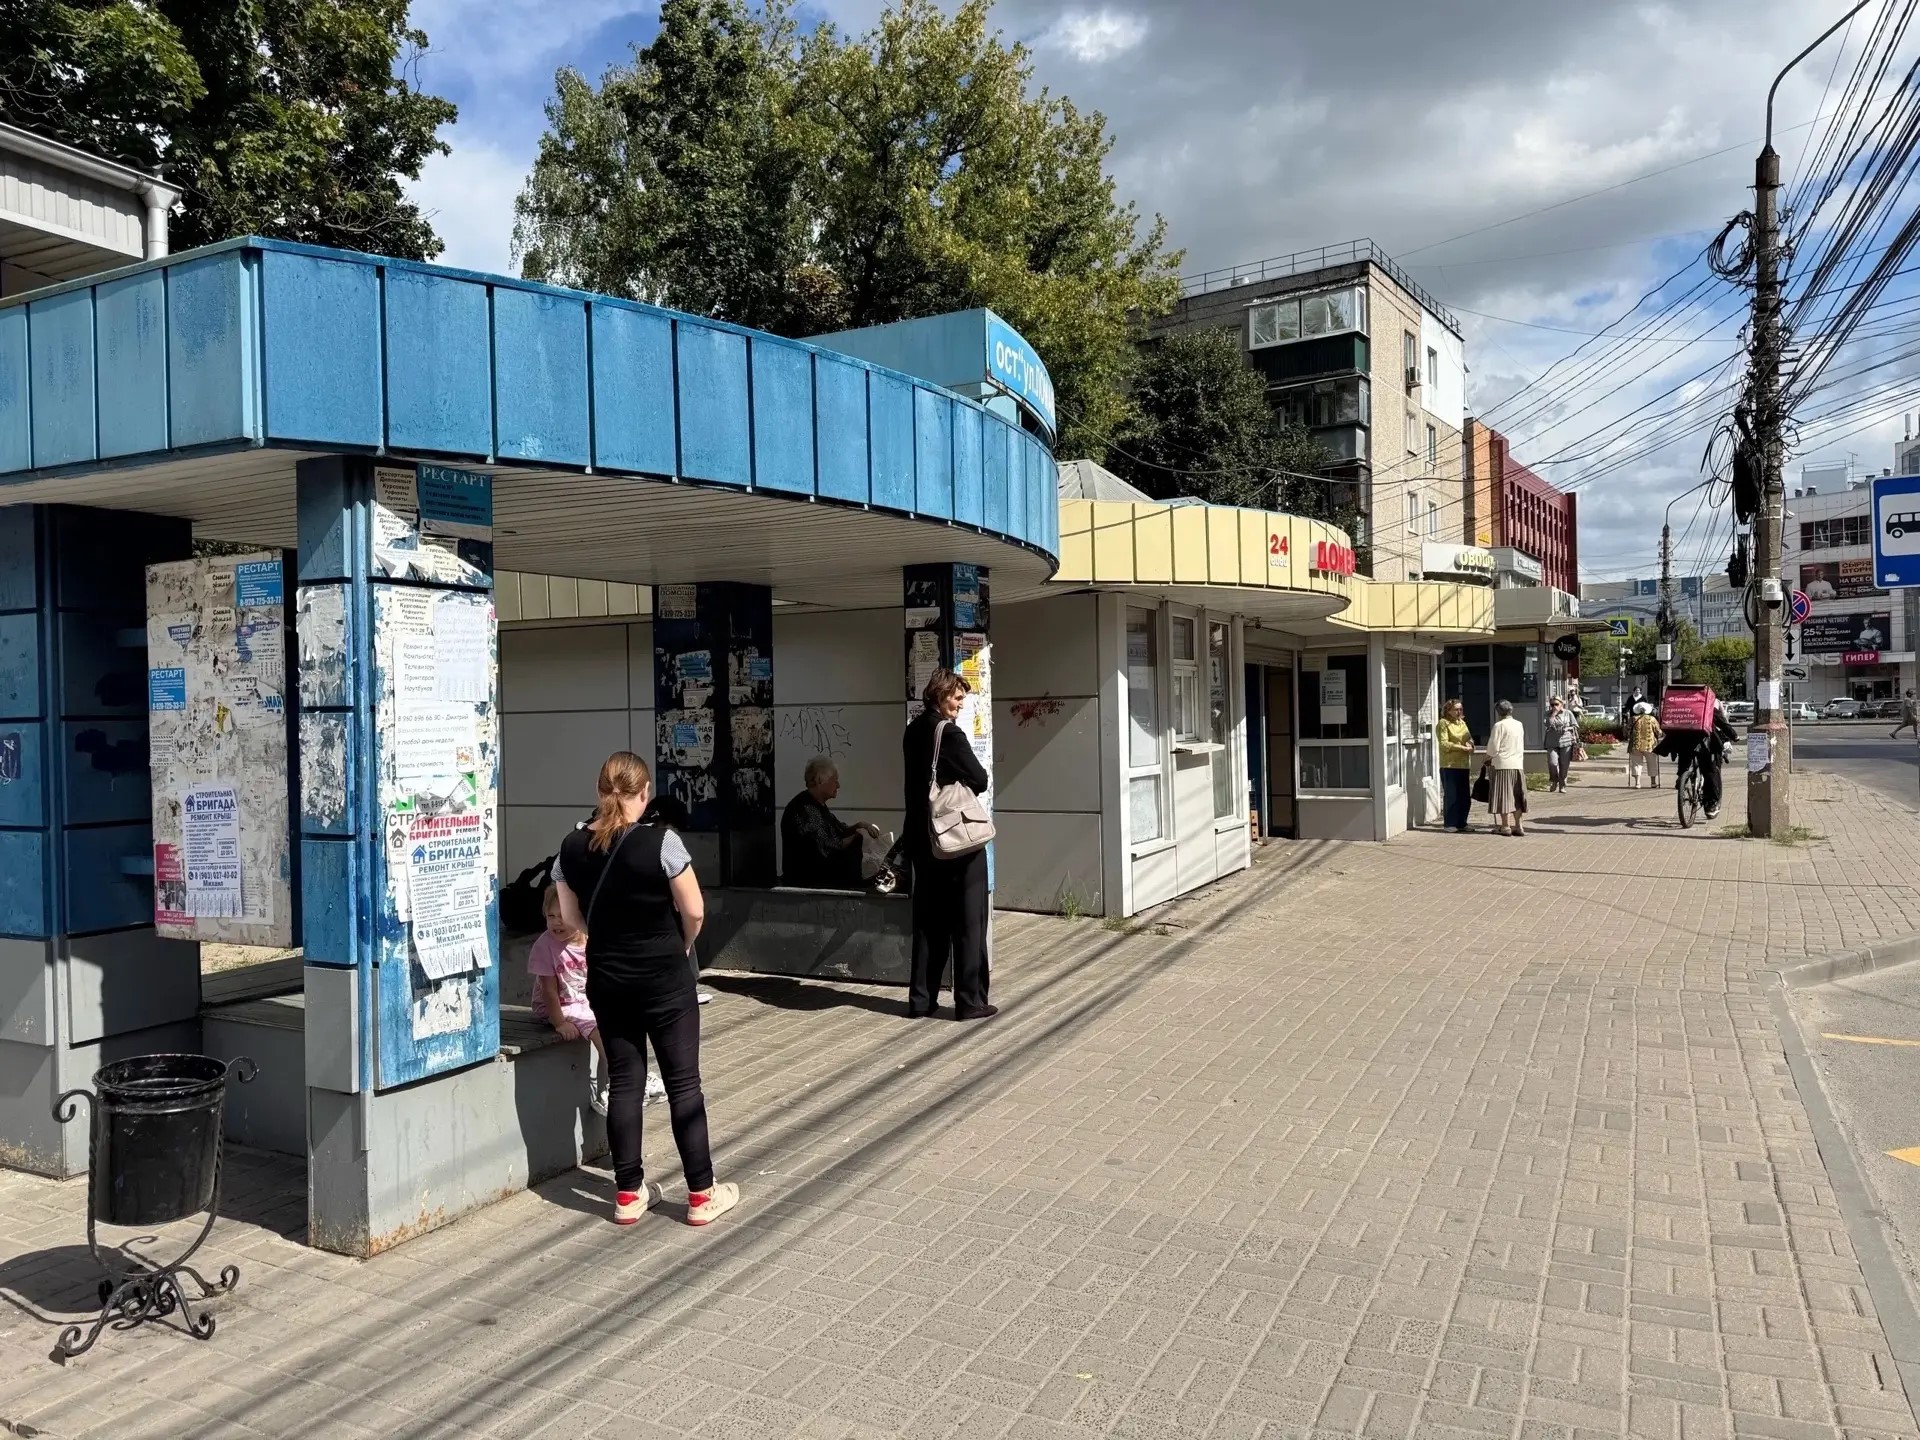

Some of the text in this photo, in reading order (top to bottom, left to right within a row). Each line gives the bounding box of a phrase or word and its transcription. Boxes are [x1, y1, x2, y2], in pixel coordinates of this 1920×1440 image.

[422, 466, 486, 487] РЕСТАРТ
[1270, 534, 1288, 555] 24
[238, 562, 279, 574] РЕСТАРТ
[1845, 653, 1874, 662] ГИПЕР
[151, 670, 183, 680] РЕСТАРТ
[196, 790, 232, 798] СТРОИТЕЛЬНАЯ
[196, 799, 235, 811] БРИГАДА
[411, 815, 480, 830] СТРОИТЕЛЬНАЯ
[428, 836, 481, 849] СТРОИТЕЛЬНАЯ
[429, 845, 480, 861] БРИГАДА
[419, 860, 475, 874] РЕМОНТ КРЫШ
[195, 871, 198, 880] 8
[199, 872, 212, 880] (903)
[431, 926, 448, 937] (903)
[448, 920, 482, 934] 027-40-02
[436, 932, 465, 944] Михаил
